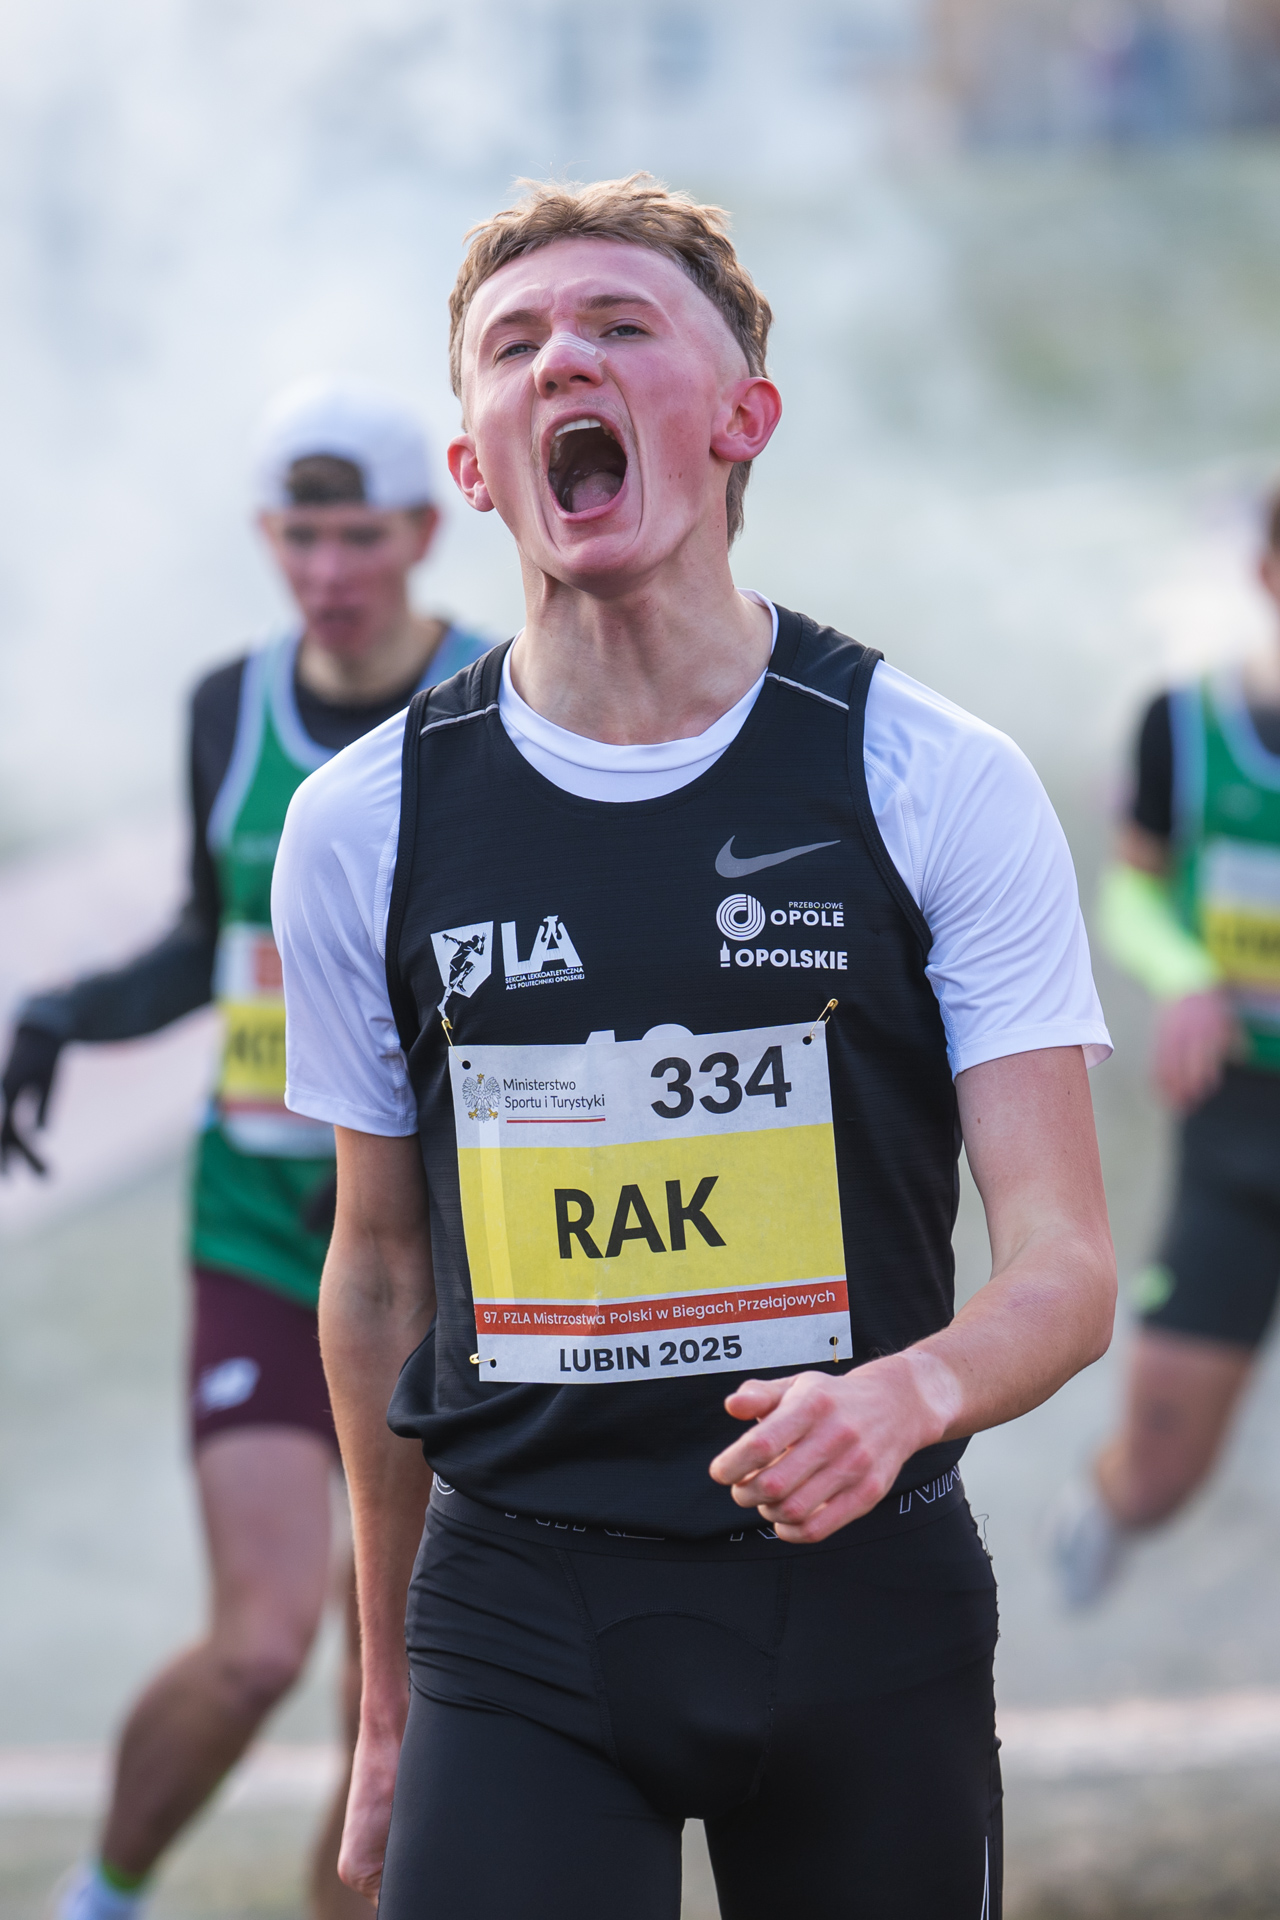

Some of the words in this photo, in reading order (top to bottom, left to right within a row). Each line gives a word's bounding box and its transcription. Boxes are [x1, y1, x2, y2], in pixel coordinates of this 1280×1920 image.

[788, 901, 844, 910] PRZEBOJOWE
[770, 909, 845, 927] OPOLE
[501, 914, 584, 977] LA
[735, 948, 848, 970] OPOLSKIE
[505, 975, 527, 984] SEKCJA
[527, 967, 584, 980] LEKKOATLETYCZNA
[555, 974, 585, 983] OPOLSKIEJ
[503, 1078, 577, 1091] Ministerstwo
[650, 1045, 792, 1119] 334
[504, 1095, 541, 1111] Sportu
[544, 1095, 548, 1108] i
[550, 1094, 605, 1111] Turystyki
[554, 1175, 727, 1259] RAK
[483, 1311, 501, 1324] 97.
[503, 1312, 531, 1324] PZLA
[533, 1312, 605, 1325] Mistrzostwa
[609, 1307, 652, 1324] Polski
[655, 1308, 669, 1319] w
[672, 1300, 734, 1319] Biegach
[738, 1289, 836, 1311] Przełajowych
[560, 1345, 651, 1372] LUBIN
[659, 1335, 742, 1366] 2025
